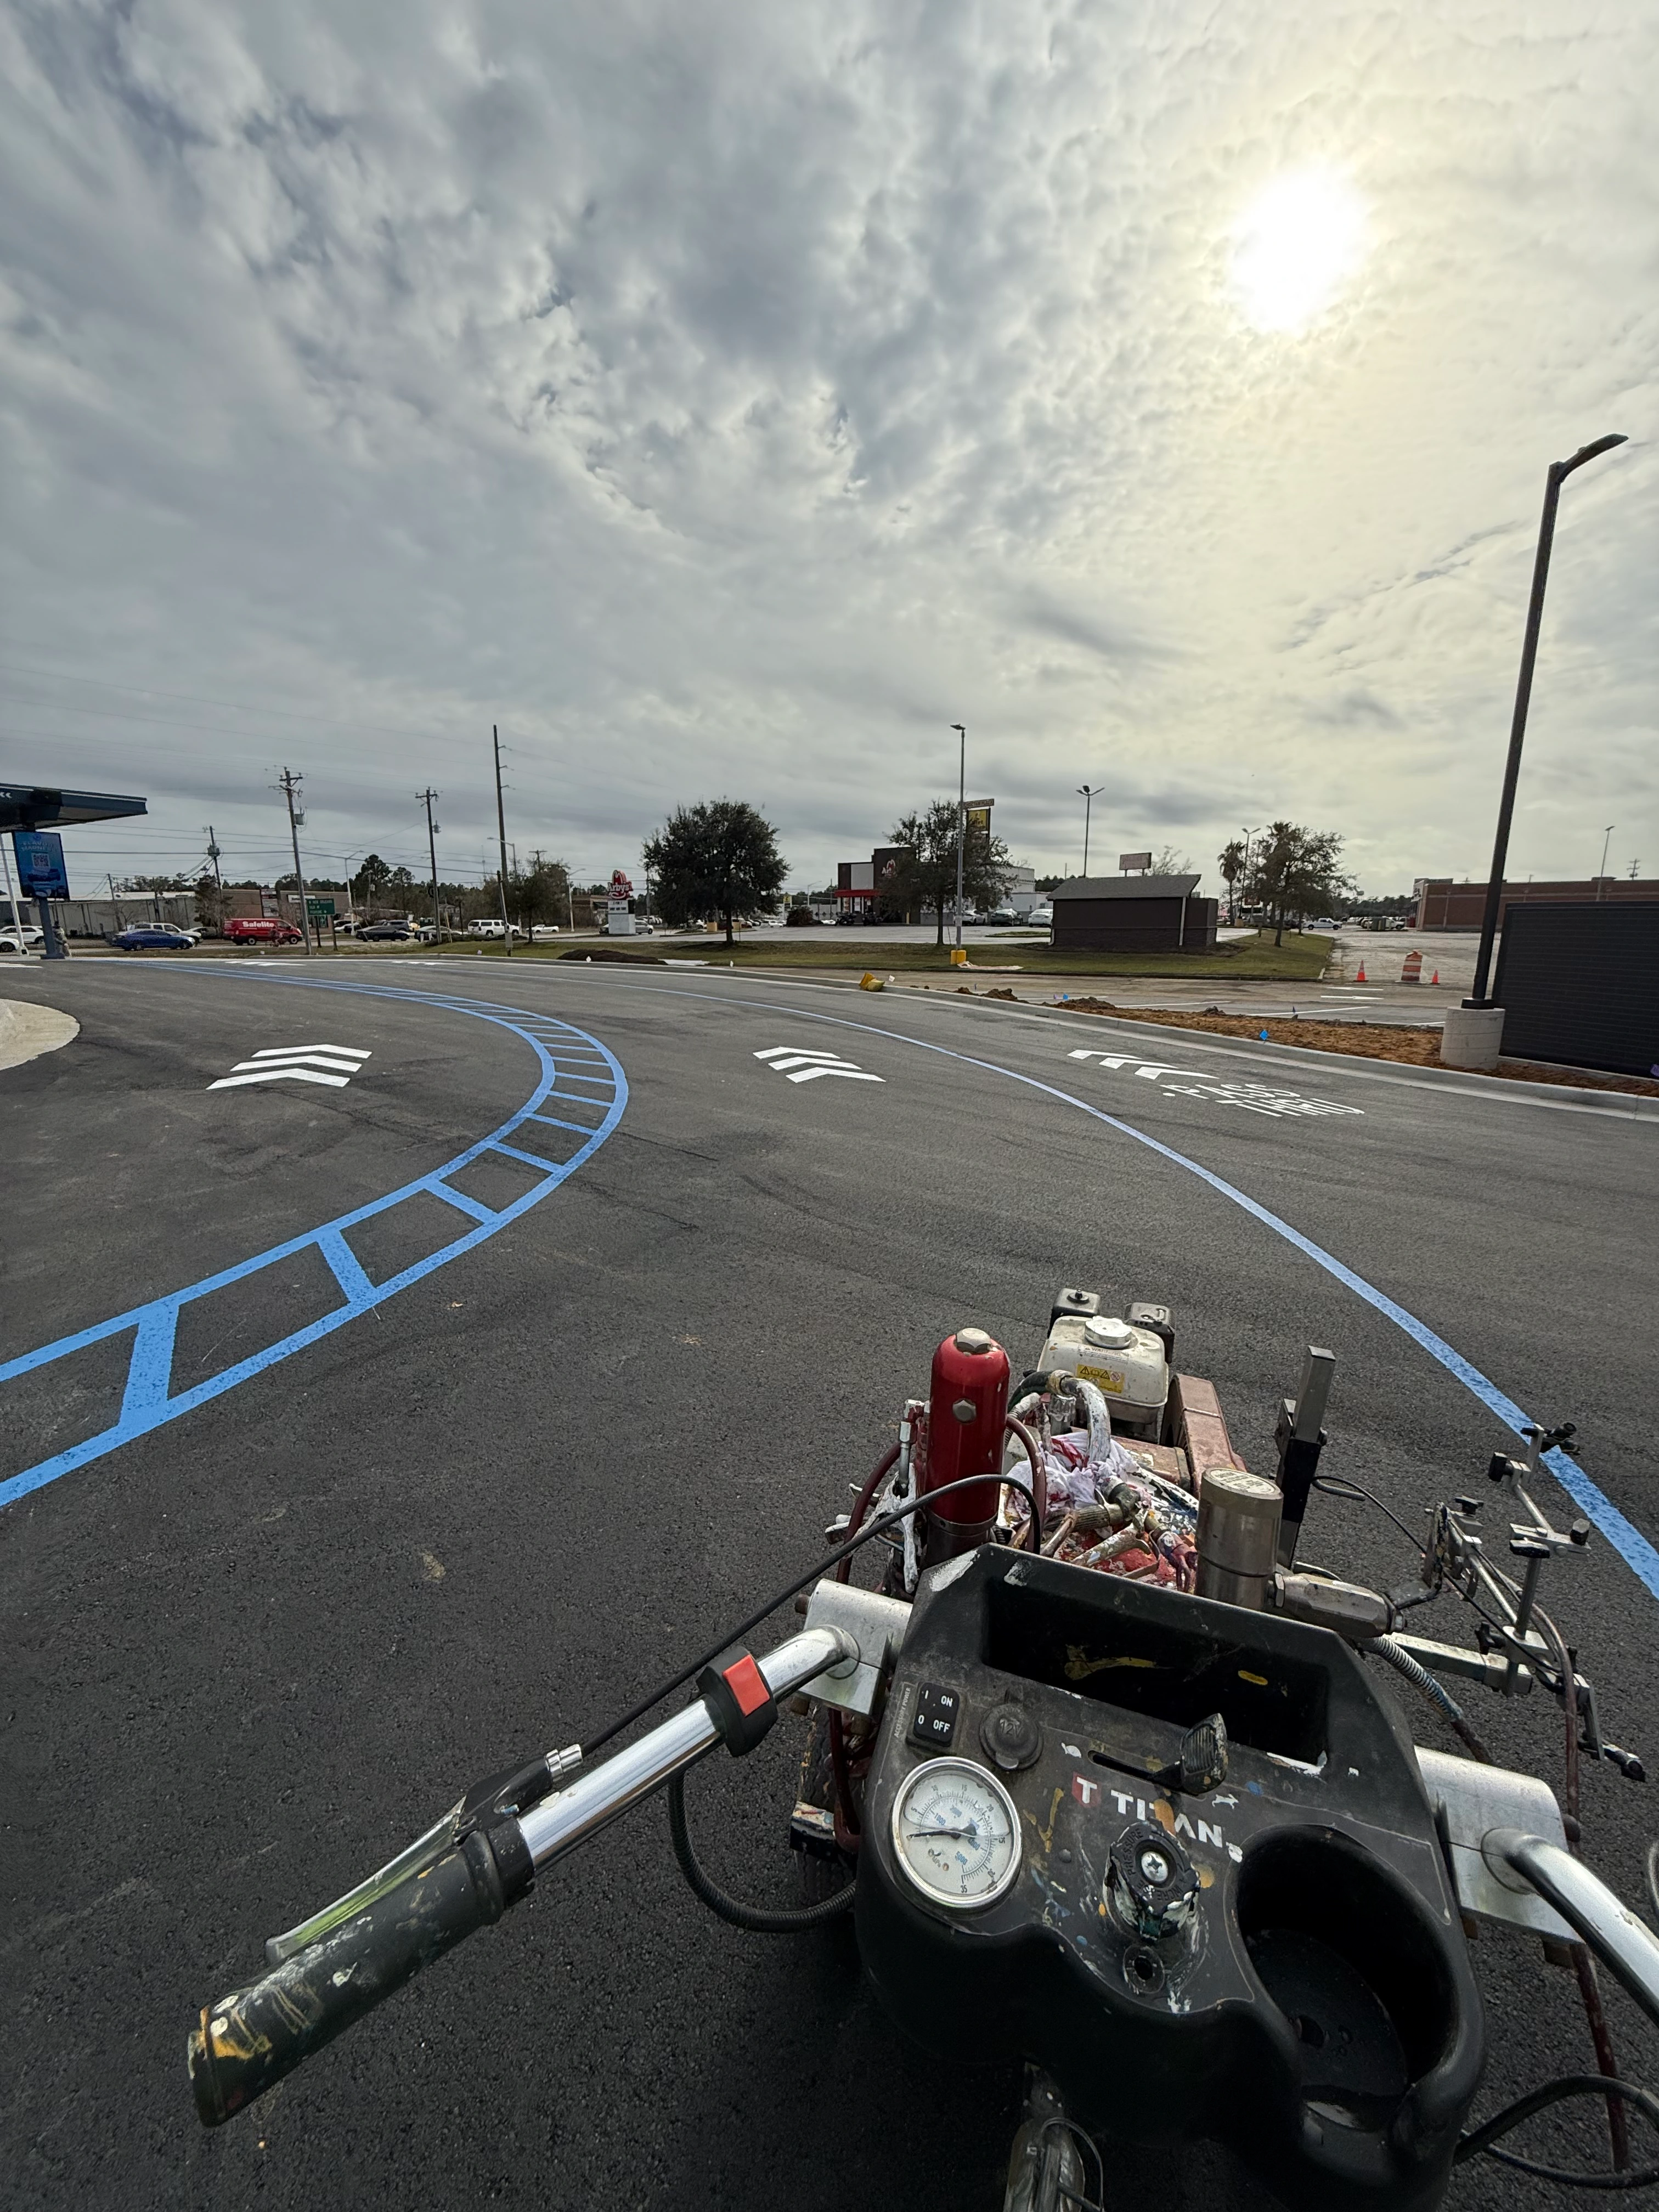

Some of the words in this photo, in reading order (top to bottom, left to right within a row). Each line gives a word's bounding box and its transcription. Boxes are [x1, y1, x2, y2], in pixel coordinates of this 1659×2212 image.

[1159, 1084, 1301, 1099] PASS
[1215, 1098, 1364, 1117] THRU
[941, 1695, 953, 1707] ON
[894, 1706, 906, 1738] ACCESSORY
[902, 1688, 911, 1706] POWER
[933, 1719, 950, 1733] OFF
[1000, 1719, 1023, 1738] 12V
[962, 1784, 967, 1792] 15
[987, 1804, 994, 1813] 20
[1077, 1777, 1097, 1803] T
[1111, 1790, 1222, 1848] TIAN
[934, 1813, 946, 1826] 1000
[956, 1850, 968, 1865] 5000
[1124, 1828, 1144, 1876] PRESSURE
[961, 1885, 968, 1893] 35
